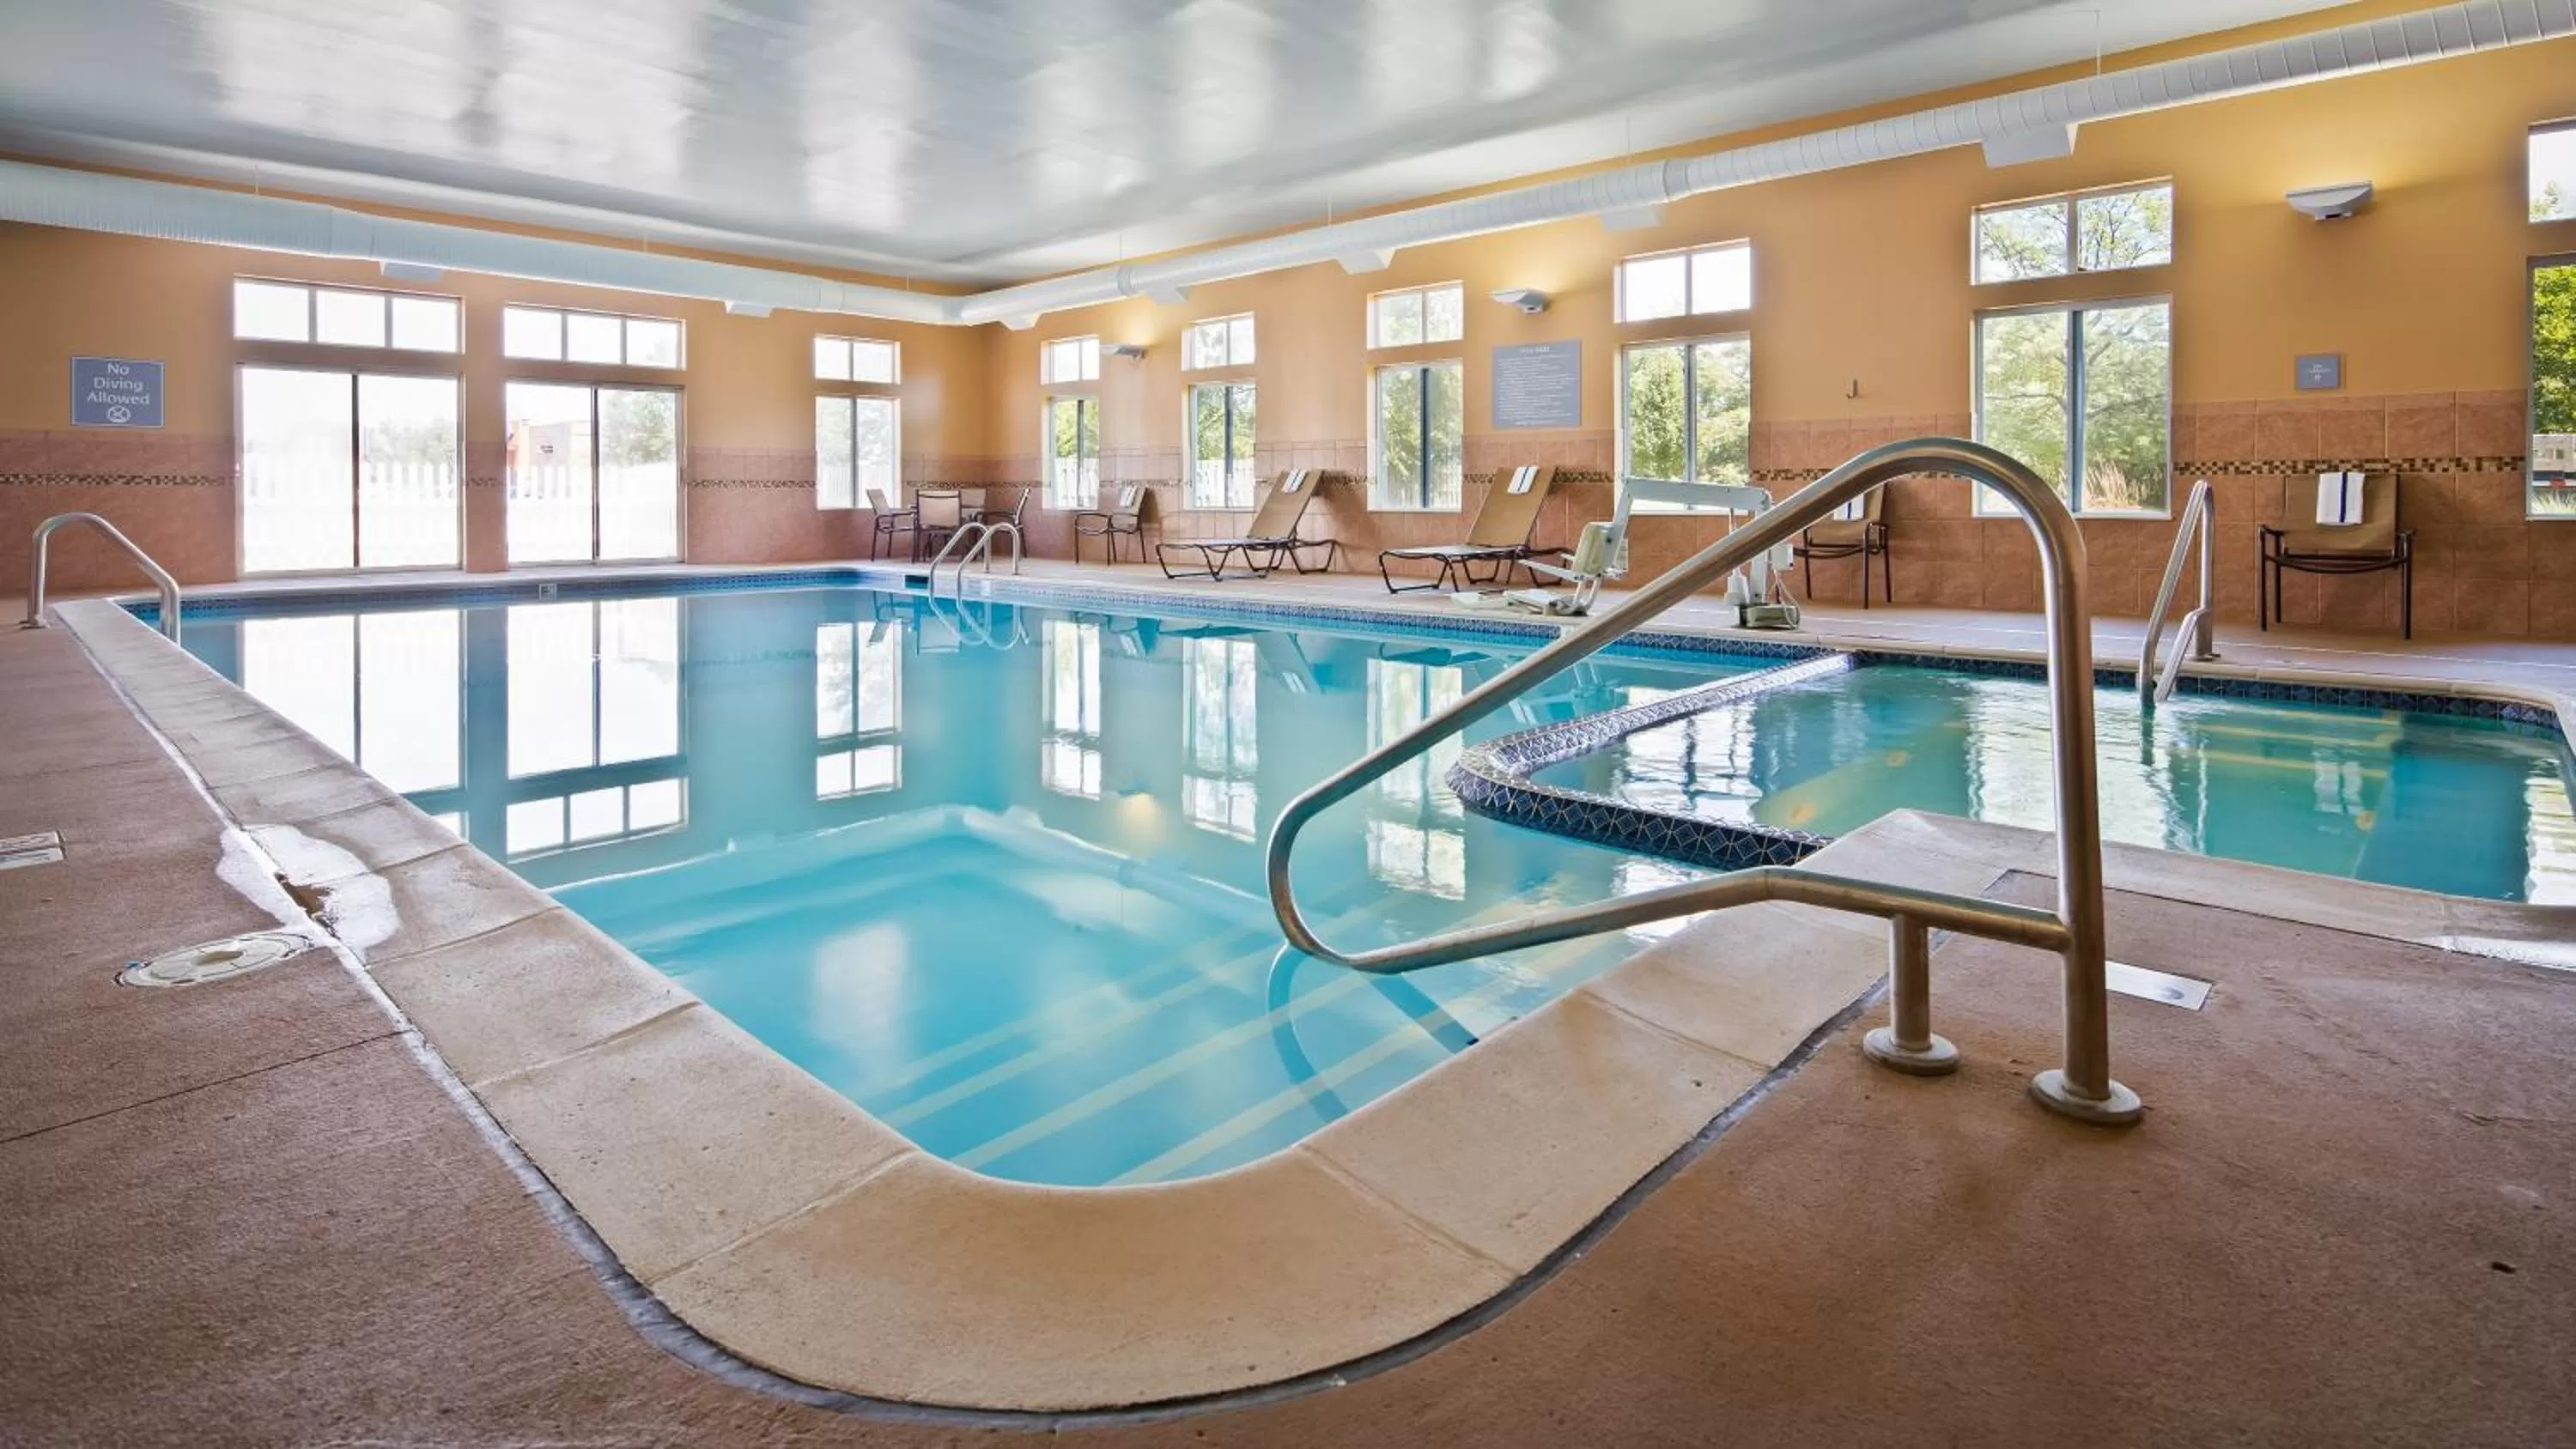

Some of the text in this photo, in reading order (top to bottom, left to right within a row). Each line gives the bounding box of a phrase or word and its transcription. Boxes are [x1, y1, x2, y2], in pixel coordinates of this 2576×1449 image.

[107, 363, 130, 375] No
[94, 377, 143, 392] Diving
[87, 391, 150, 405] Allowed
